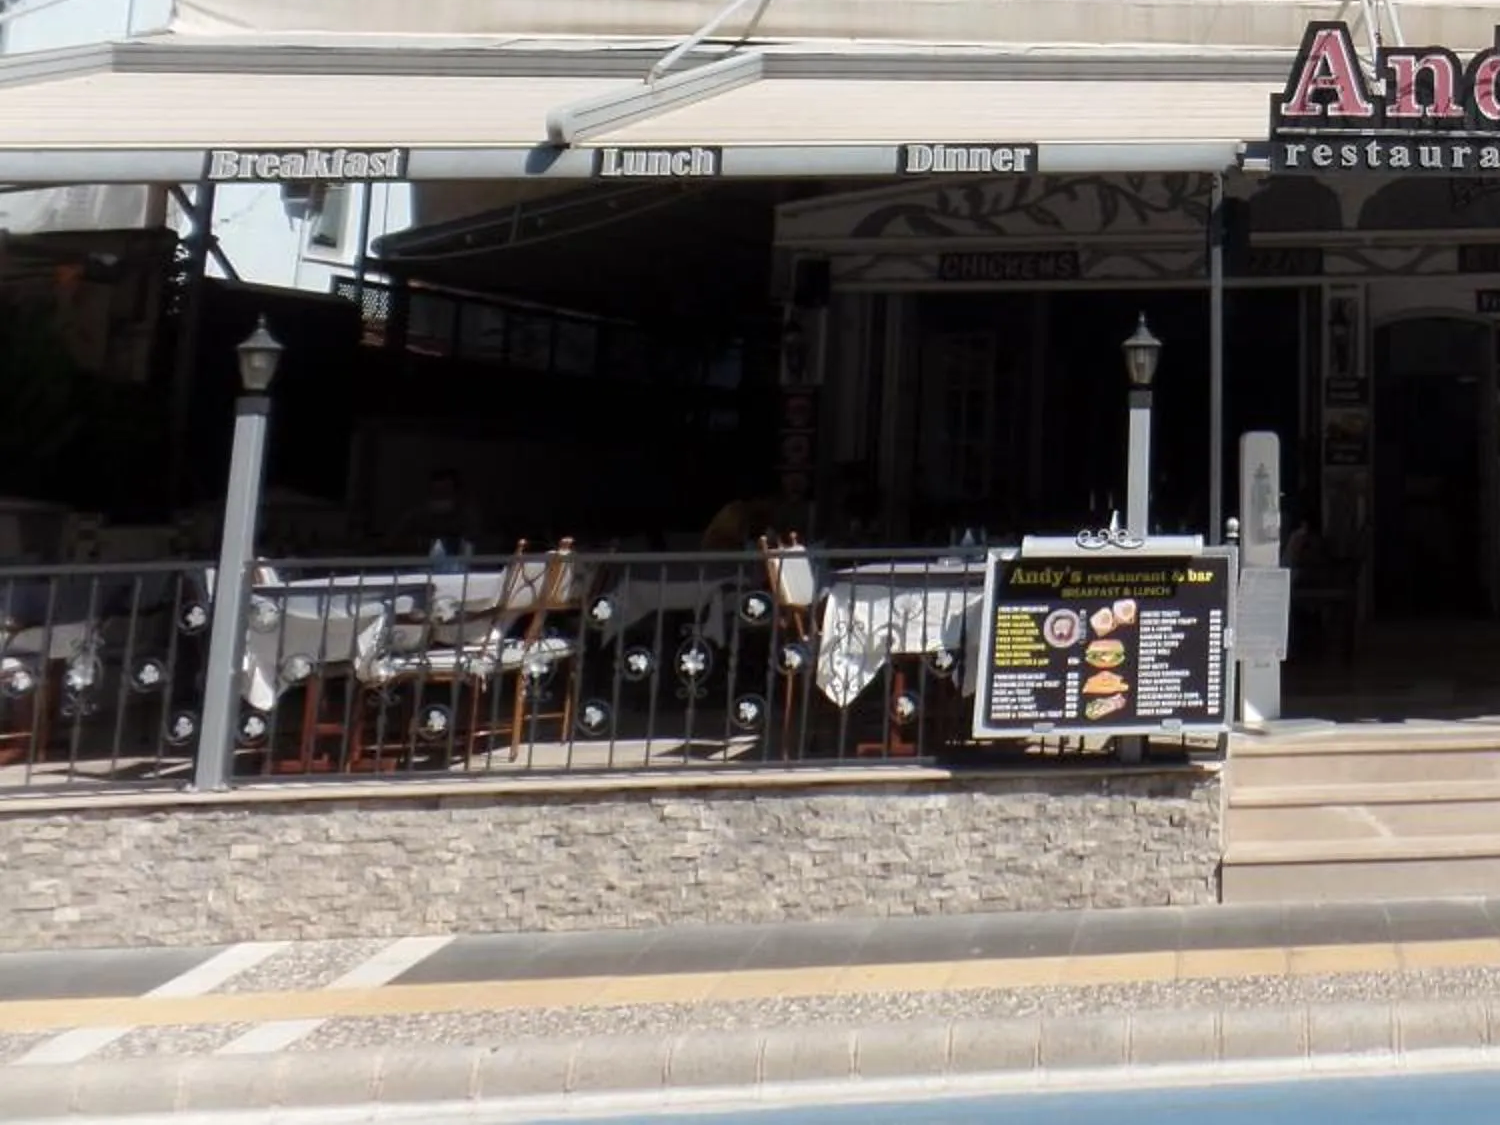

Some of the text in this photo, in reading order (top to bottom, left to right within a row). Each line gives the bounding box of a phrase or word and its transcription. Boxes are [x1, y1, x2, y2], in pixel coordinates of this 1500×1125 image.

[209, 148, 402, 180] Breakfast
[601, 146, 715, 177] Lunch
[905, 144, 1031, 173] Dinner
[1009, 567, 1082, 588] Andy's
[1187, 568, 1214, 583] bar
